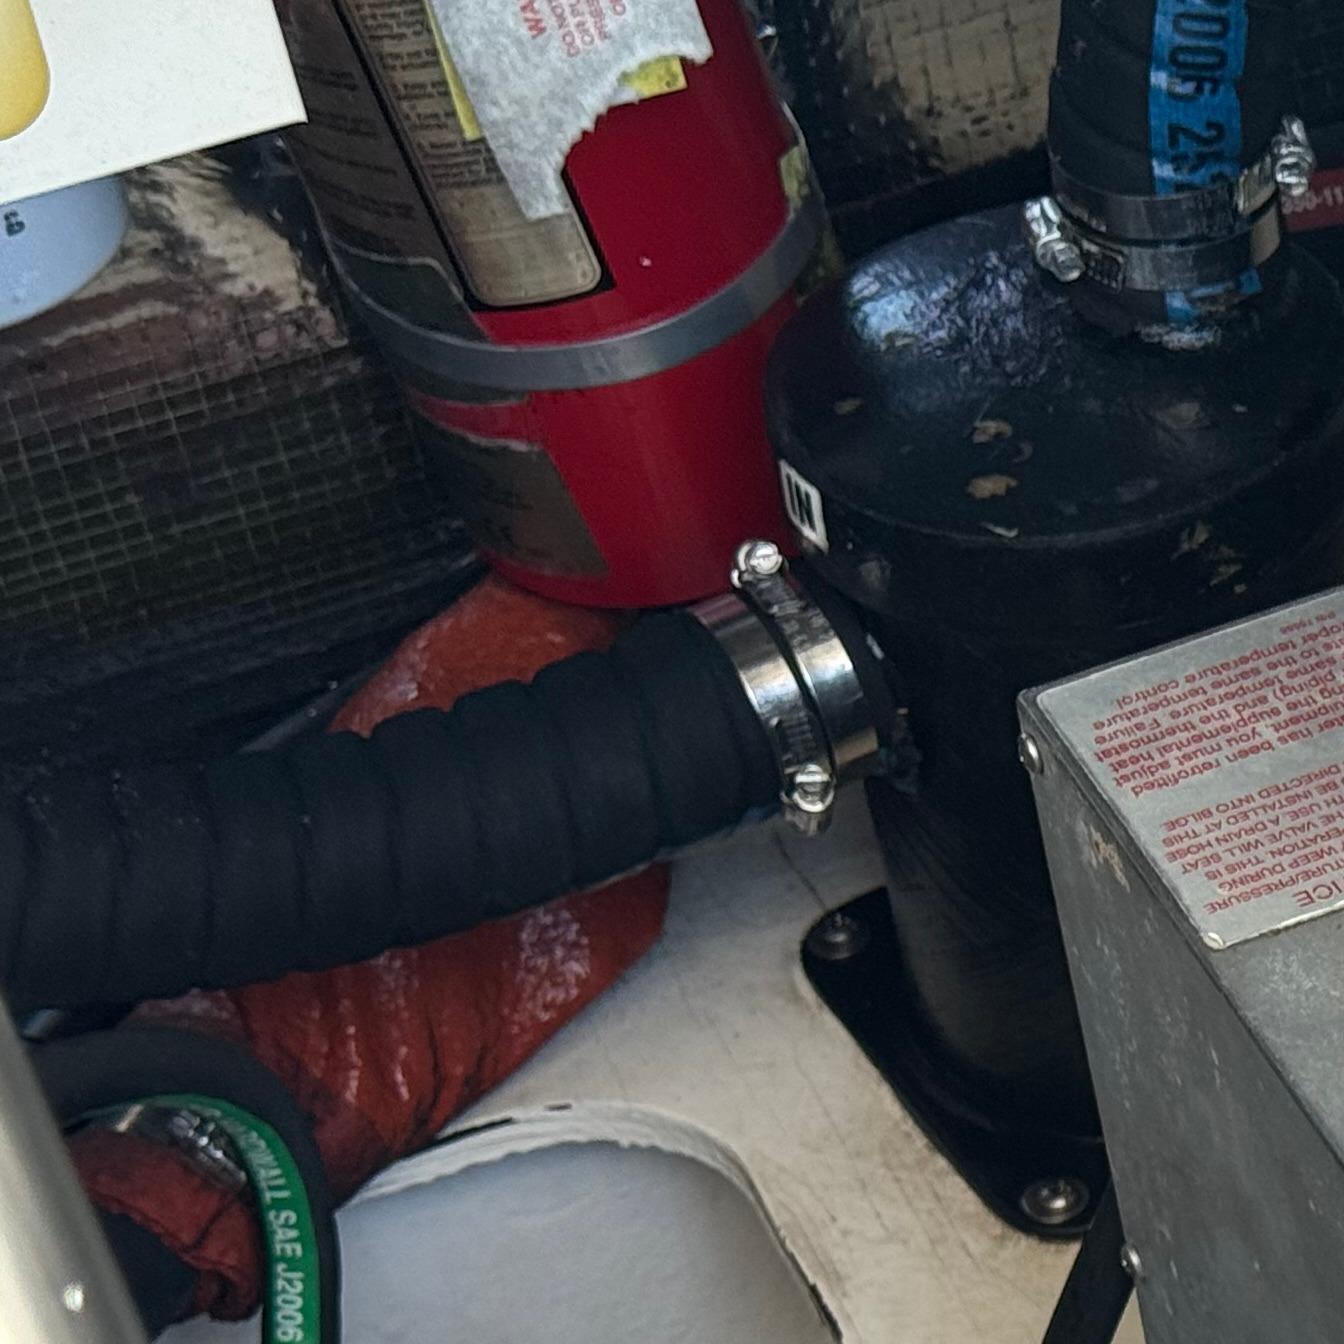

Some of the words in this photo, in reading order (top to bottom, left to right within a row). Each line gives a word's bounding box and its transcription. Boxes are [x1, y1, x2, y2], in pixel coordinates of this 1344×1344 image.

[1167, 0, 1231, 96] 006
[1180, 638, 1299, 686] temperature
[1262, 652, 1299, 673] the
[1295, 645, 1321, 662] to
[1206, 664, 1264, 692] same
[1282, 654, 1341, 682] same
[1268, 670, 1339, 702] piping)
[1087, 682, 1209, 731] temperature
[1229, 692, 1273, 715] and
[1281, 692, 1319, 713] the
[1194, 705, 1233, 727] the
[1089, 714, 1162, 747] Failure
[1090, 717, 1197, 762] thermostat
[1152, 704, 1284, 756] supplemental
[1222, 726, 1263, 748] you
[1273, 725, 1314, 747] has
[1104, 747, 1154, 773] heat
[1171, 739, 1225, 766] must
[1222, 738, 1276, 764] been
[1108, 756, 1173, 787] adjust
[1127, 756, 1224, 797] retrofitted
[1254, 762, 1342, 800] DIRECTED
[1310, 779, 1341, 796] BE
[1210, 791, 1257, 815] INTO
[1223, 788, 1315, 826] INSTALLED
[1198, 818, 1227, 835] AT
[1212, 820, 1269, 846] DRAIN
[1261, 818, 1318, 845] VALVE
[1266, 814, 1285, 827] A
[1158, 826, 1203, 849] THIS
[1162, 838, 1215, 863] HOSE
[1221, 837, 1265, 859] WILL
[1176, 851, 1224, 875] SEAT
[1221, 852, 1267, 875] THIS
[1284, 843, 1340, 870] WEEP
[1202, 867, 1225, 882] IS
[1213, 861, 1288, 895] DURING
[268, 1209, 303, 1258] SAE
[274, 1262, 306, 1343] J2006
